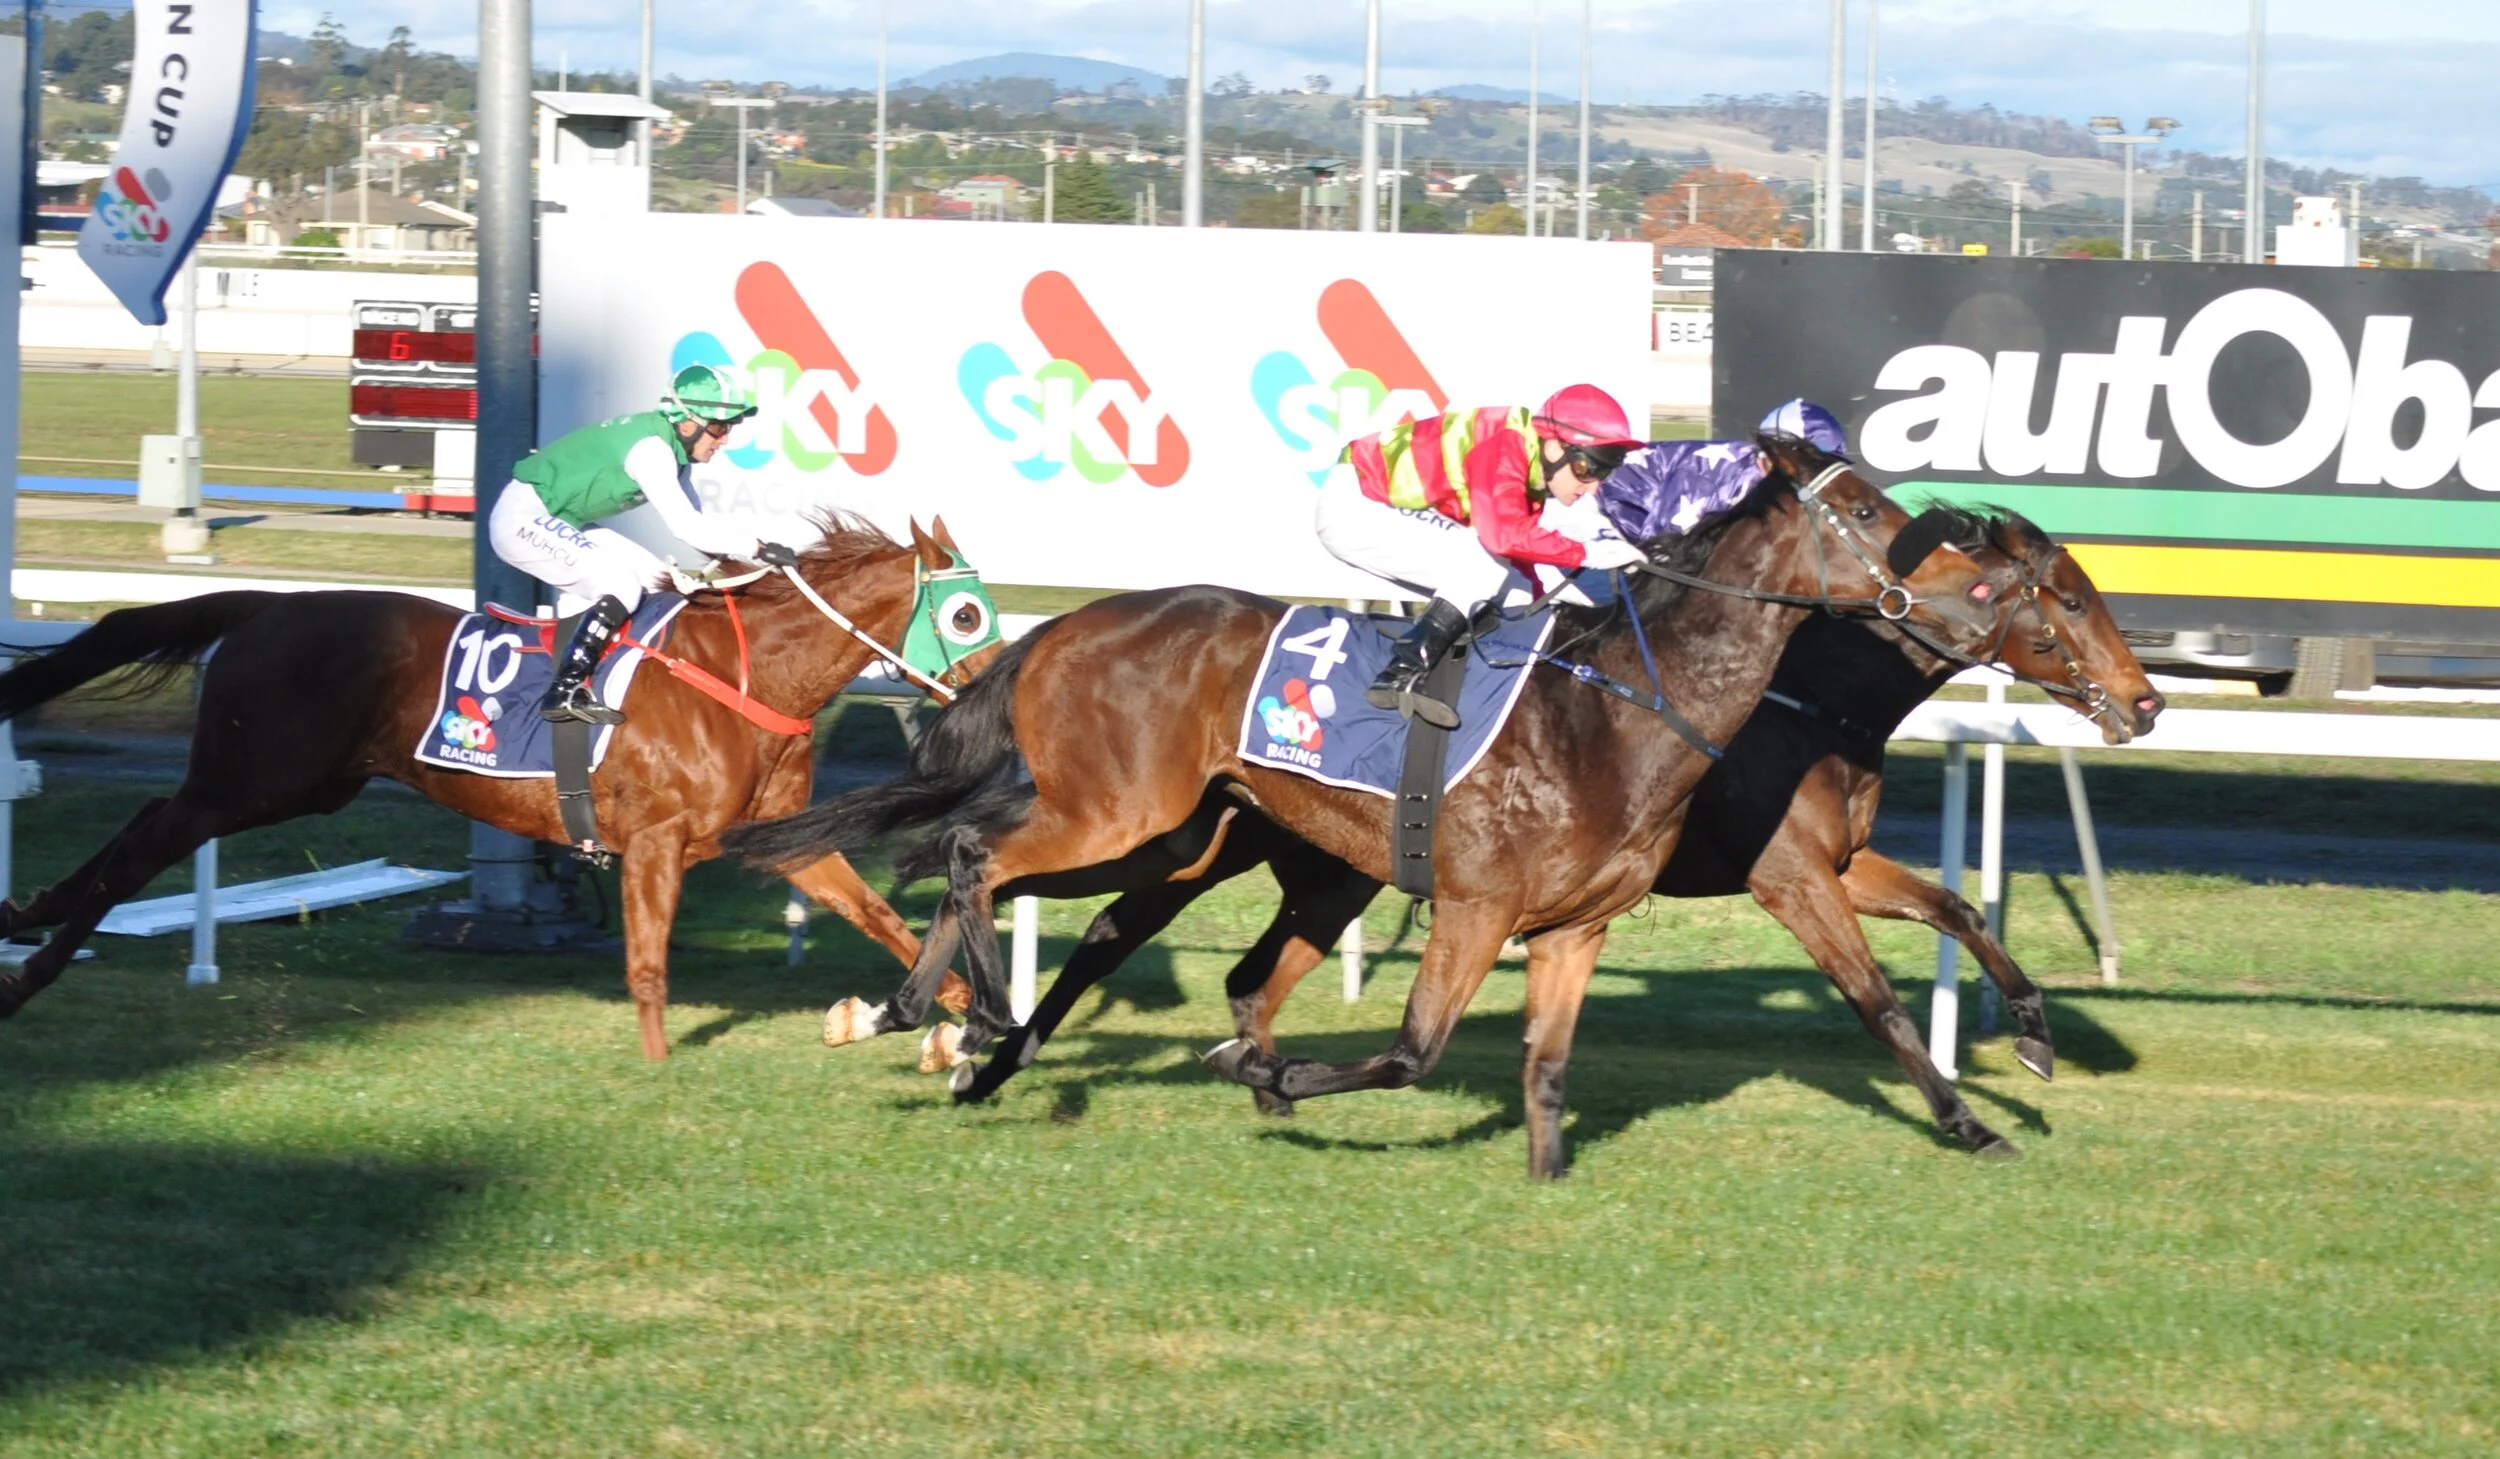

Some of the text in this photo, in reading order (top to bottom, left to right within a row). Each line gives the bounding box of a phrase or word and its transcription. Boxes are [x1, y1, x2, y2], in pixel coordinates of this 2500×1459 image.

[150, 53, 188, 149] CUP
[103, 203, 163, 235] SKY
[389, 331, 410, 360] 6
[984, 375, 1167, 465] SKY
[455, 630, 523, 694] 10
[1281, 617, 1350, 680] 4
[444, 716, 492, 745] SKY
[1266, 707, 1320, 742] SKY
[440, 744, 498, 767] RACING
[1266, 743, 1322, 768] RACING
